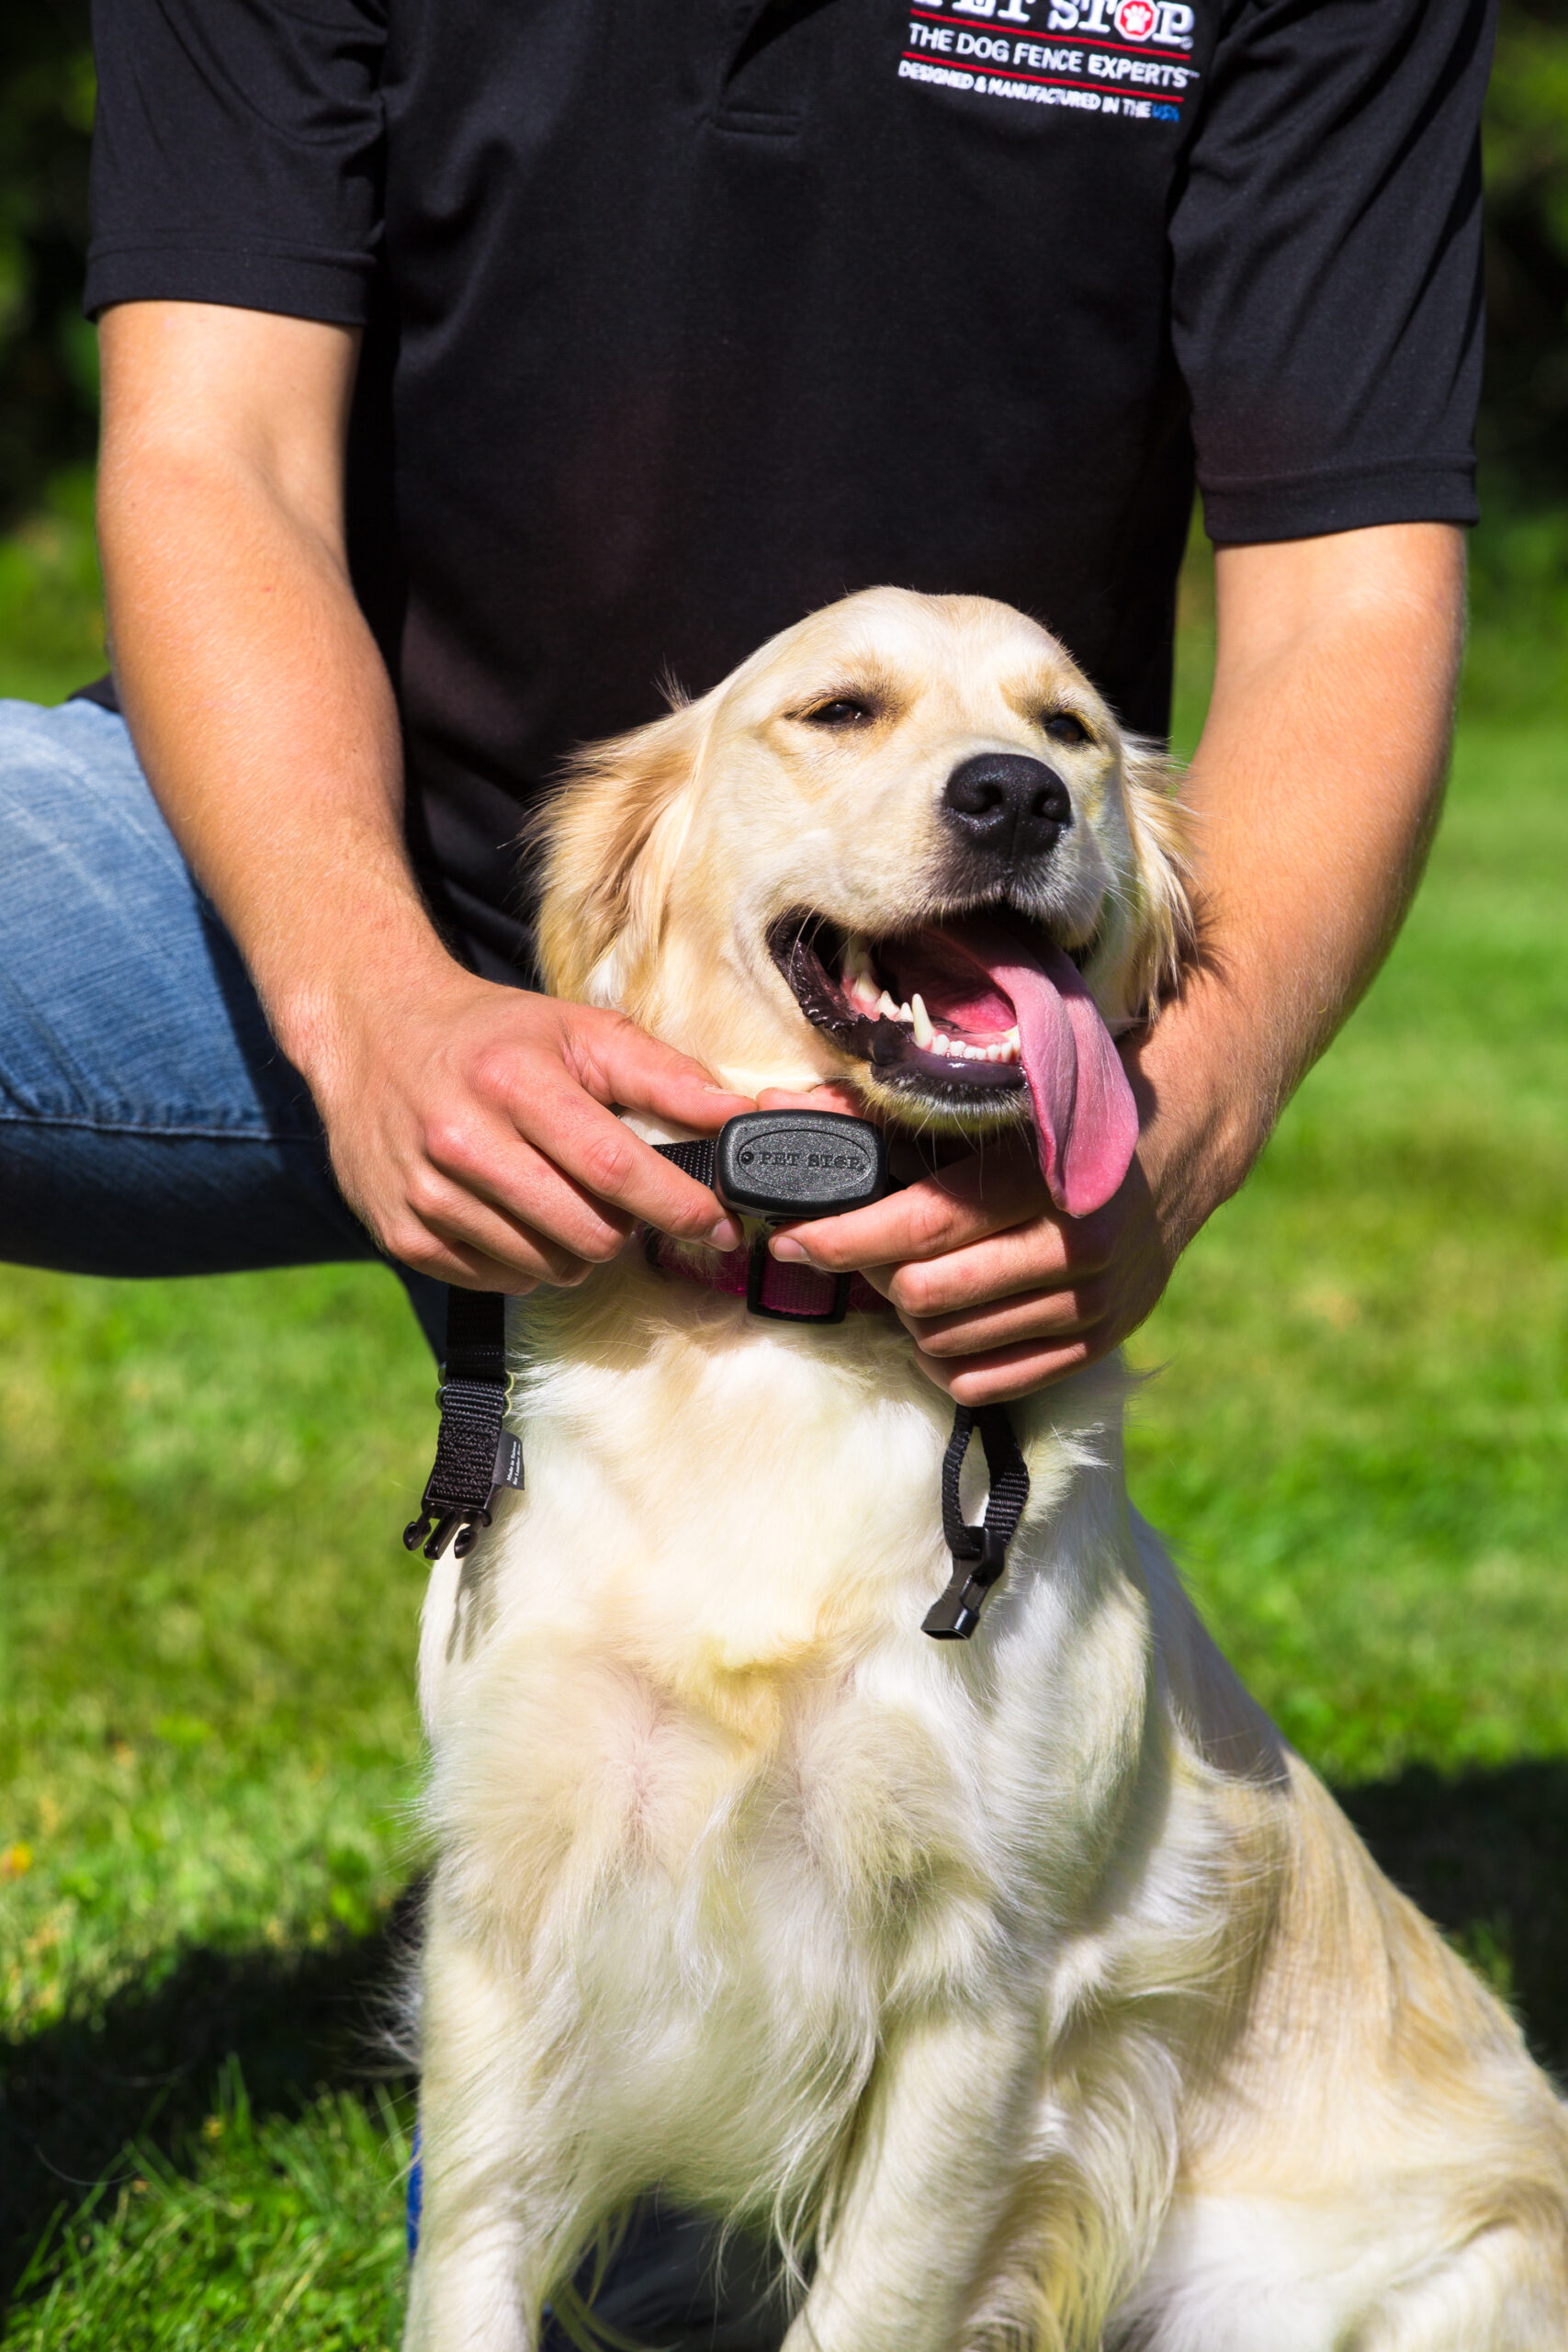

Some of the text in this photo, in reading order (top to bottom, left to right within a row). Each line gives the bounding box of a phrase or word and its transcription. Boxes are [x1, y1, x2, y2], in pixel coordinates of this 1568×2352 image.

[909, 22, 955, 51] THE
[955, 32, 1010, 62] DOG
[1013, 42, 1084, 73] FENCE
[898, 60, 1180, 122] DESIGNED & MANUFACTURED IN THE USA
[759, 1151, 801, 1167] PET
